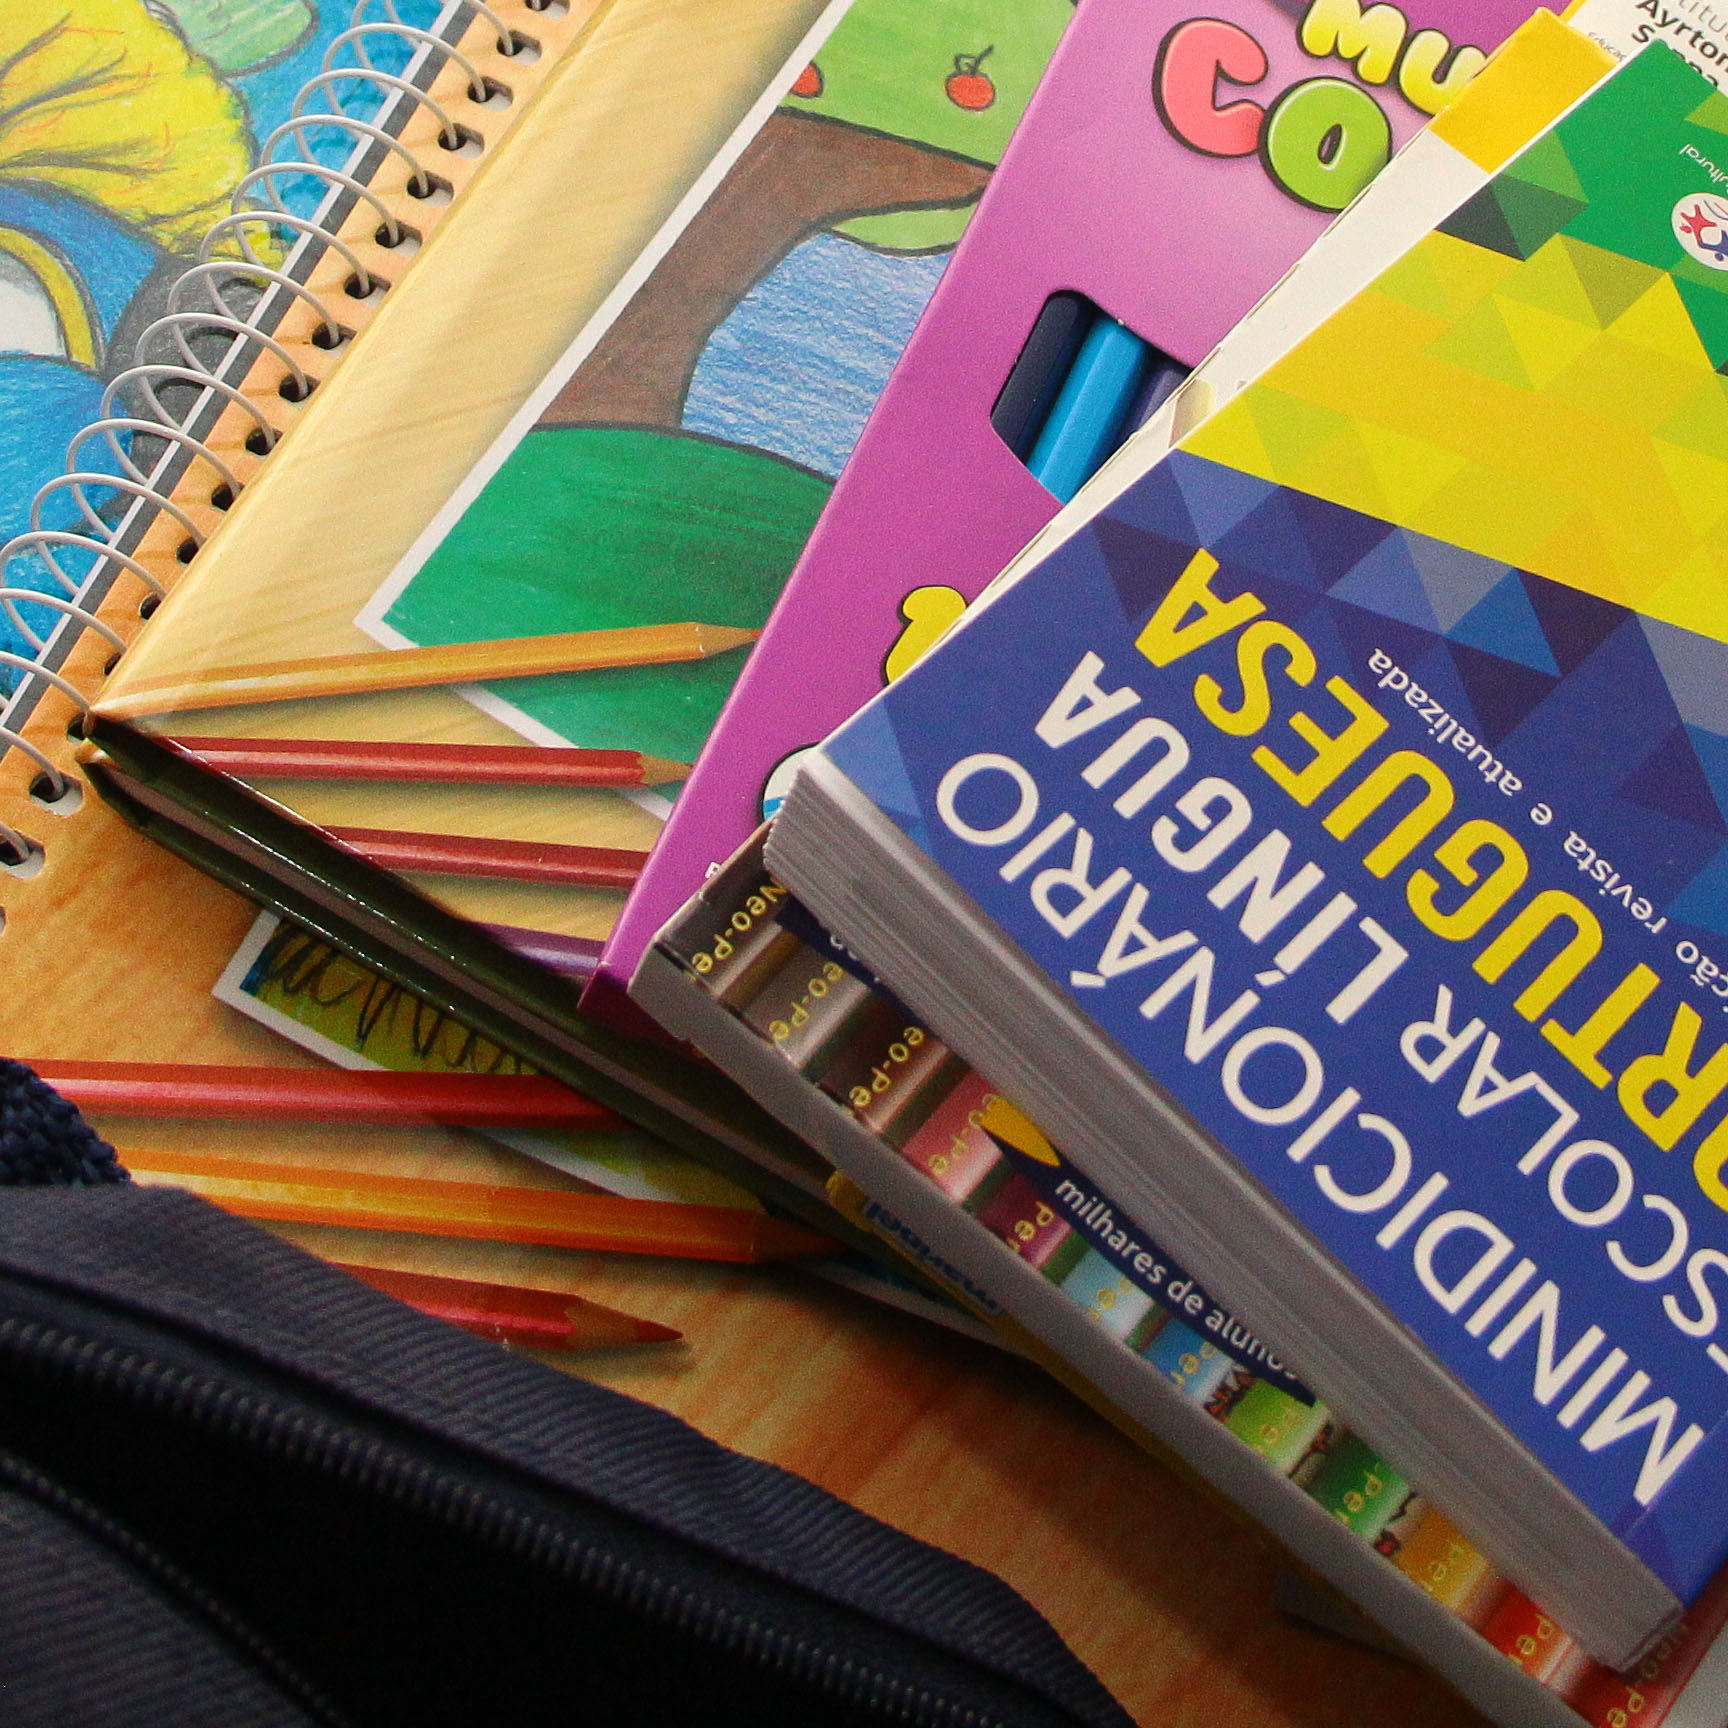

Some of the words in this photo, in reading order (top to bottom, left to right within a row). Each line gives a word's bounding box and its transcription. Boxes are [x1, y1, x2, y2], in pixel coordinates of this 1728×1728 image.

[1369, 648, 1522, 798] atualizada
[1033, 650, 1411, 1026] LÍNGUA
[1529, 801, 1552, 826] e
[1564, 833, 1668, 929] revista
[687, 877, 788, 981] Neo-Pe
[934, 751, 1705, 1507] MINIDICIONÁRIO
[1055, 1179, 1167, 1284] milhares
[1168, 1275, 1204, 1314] de
